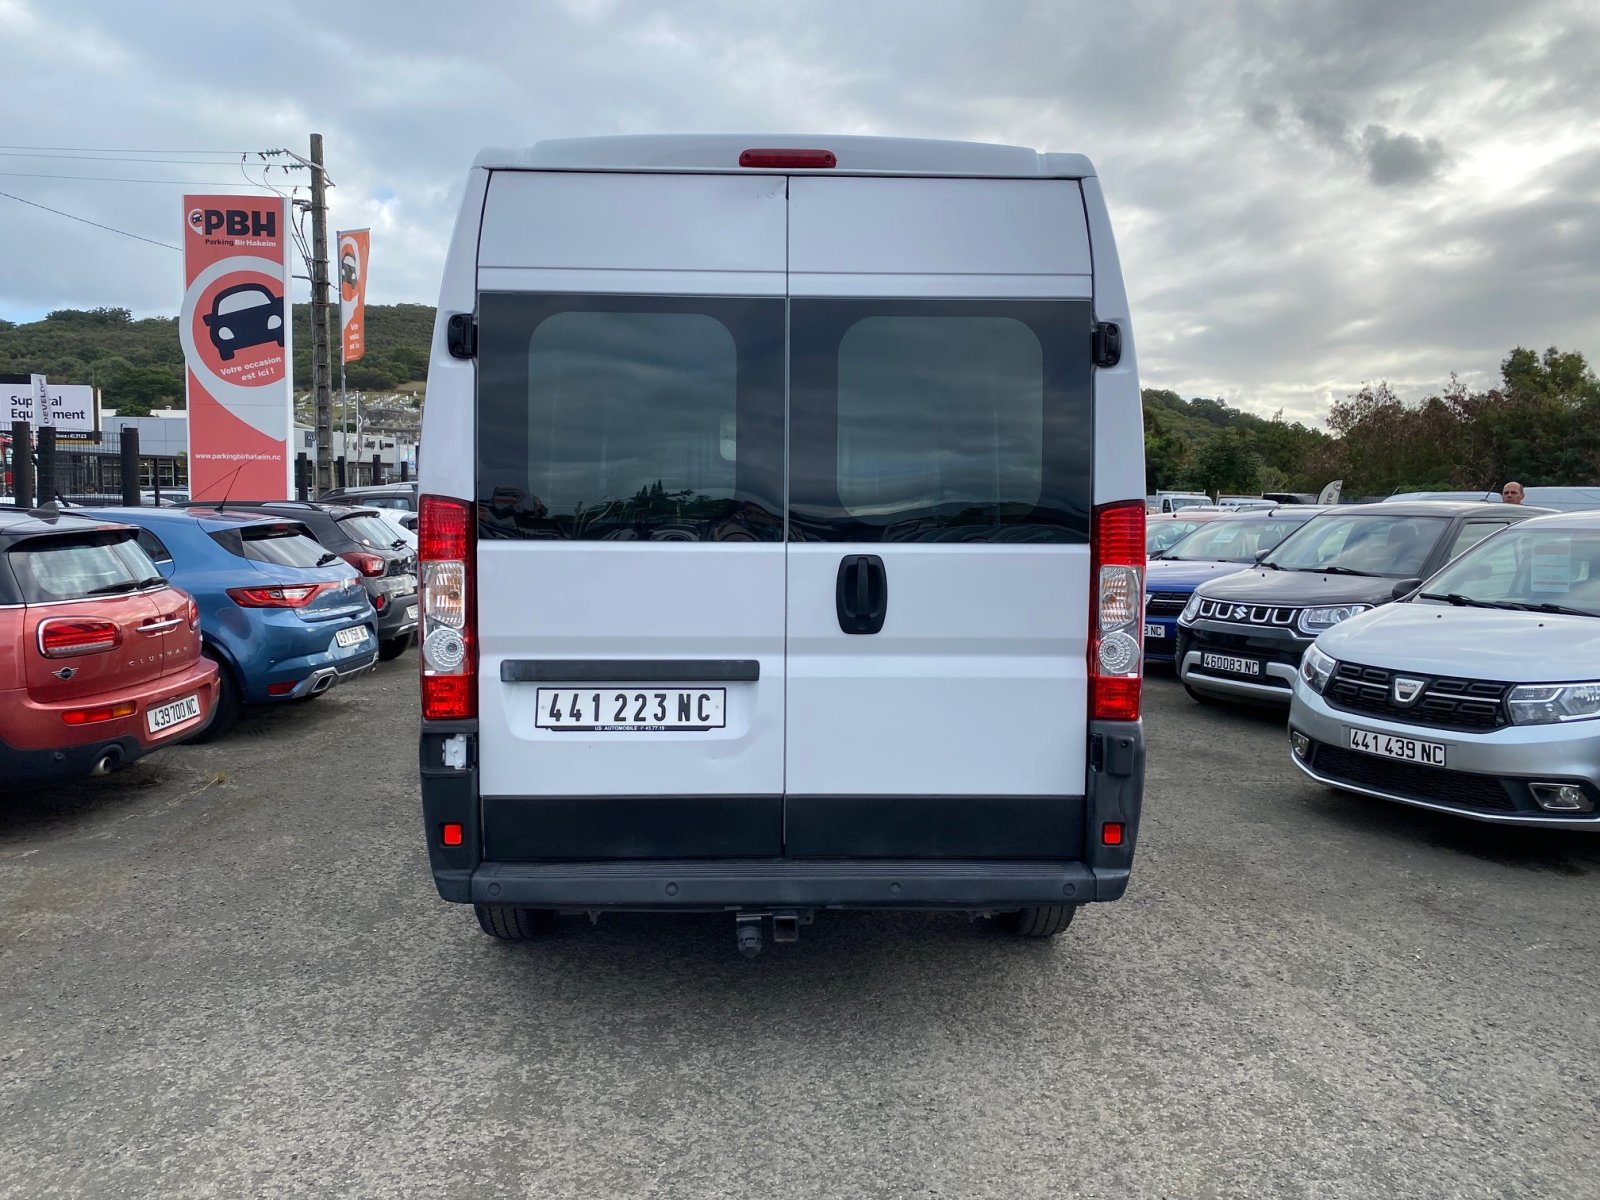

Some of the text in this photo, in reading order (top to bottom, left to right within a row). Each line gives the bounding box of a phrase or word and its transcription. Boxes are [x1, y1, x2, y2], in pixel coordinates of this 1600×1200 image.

[204, 209, 276, 238] PBH
[220, 356, 282, 376] Votre occasion
[241, 372, 256, 381] est
[258, 368, 270, 377] ici
[11, 408, 86, 421] Equment
[194, 453, 281, 461] www.parkingbirhakeim.nc
[1150, 625, 1162, 636] NC
[1244, 660, 1259, 675] NC
[186, 698, 197, 715] NC
[549, 693, 711, 722] 441 223 NC
[1351, 731, 1443, 765] 441 439 NC
